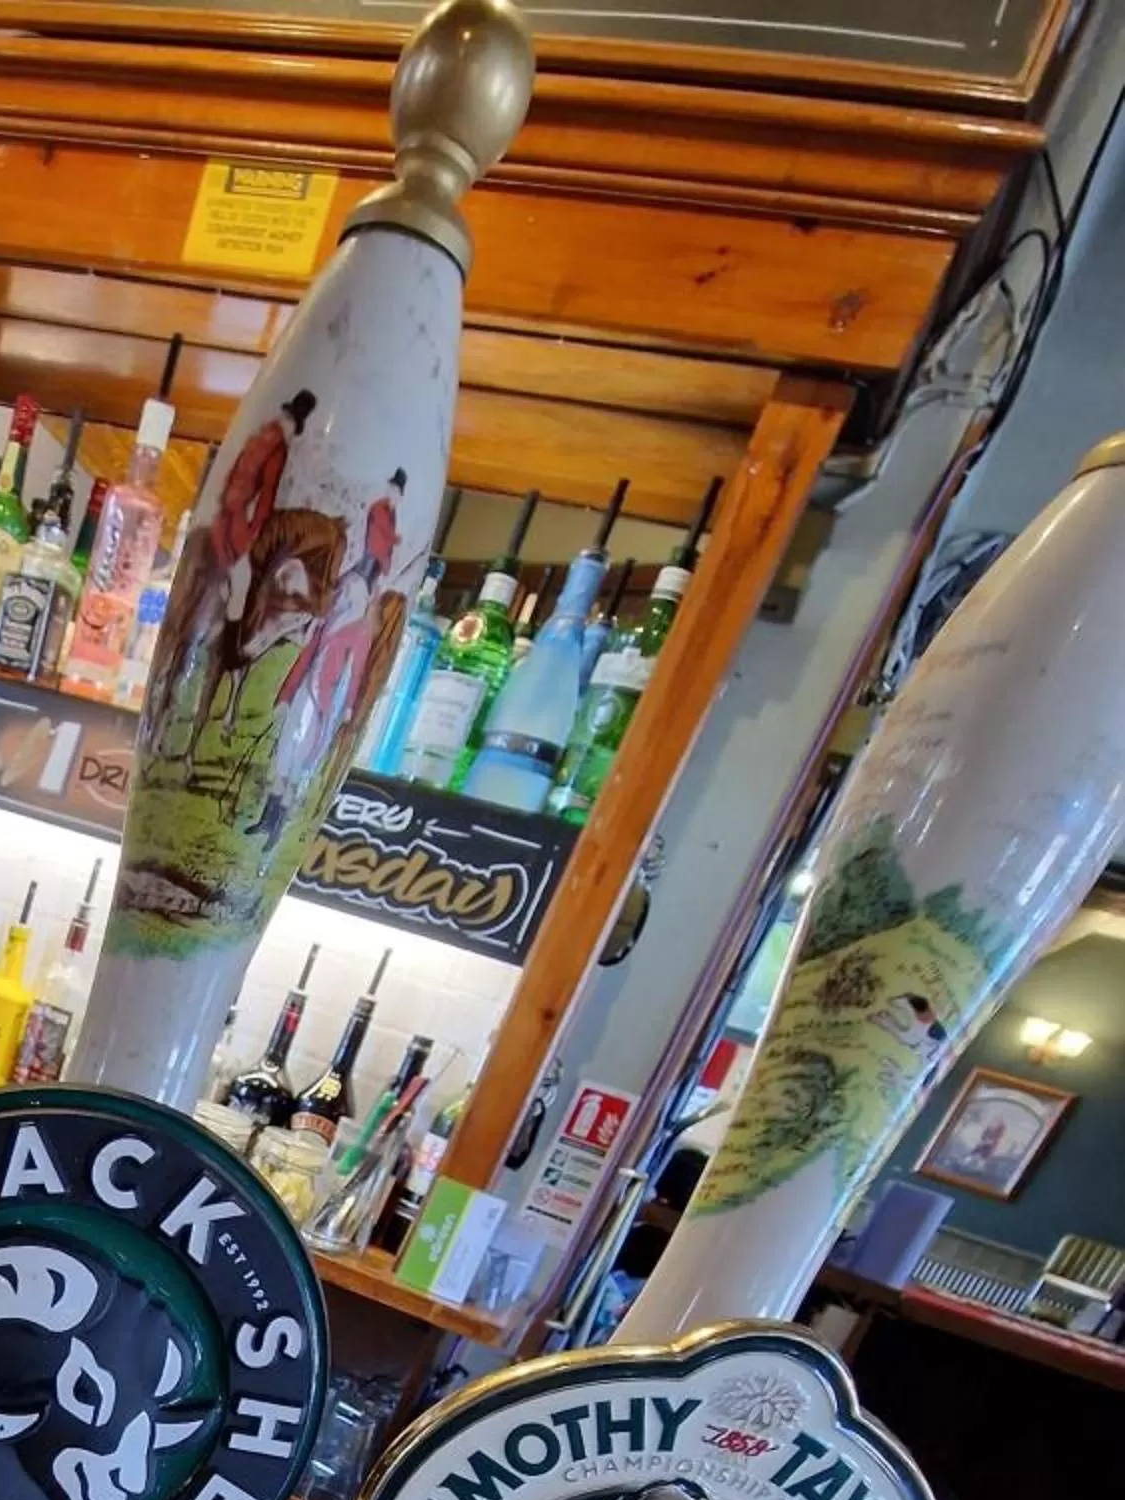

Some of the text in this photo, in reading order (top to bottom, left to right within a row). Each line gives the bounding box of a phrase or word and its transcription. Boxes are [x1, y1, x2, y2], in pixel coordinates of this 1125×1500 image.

[218, 1232, 270, 1311] EST 1992
[563, 1454, 772, 1499] CHAMPIONSHIP
